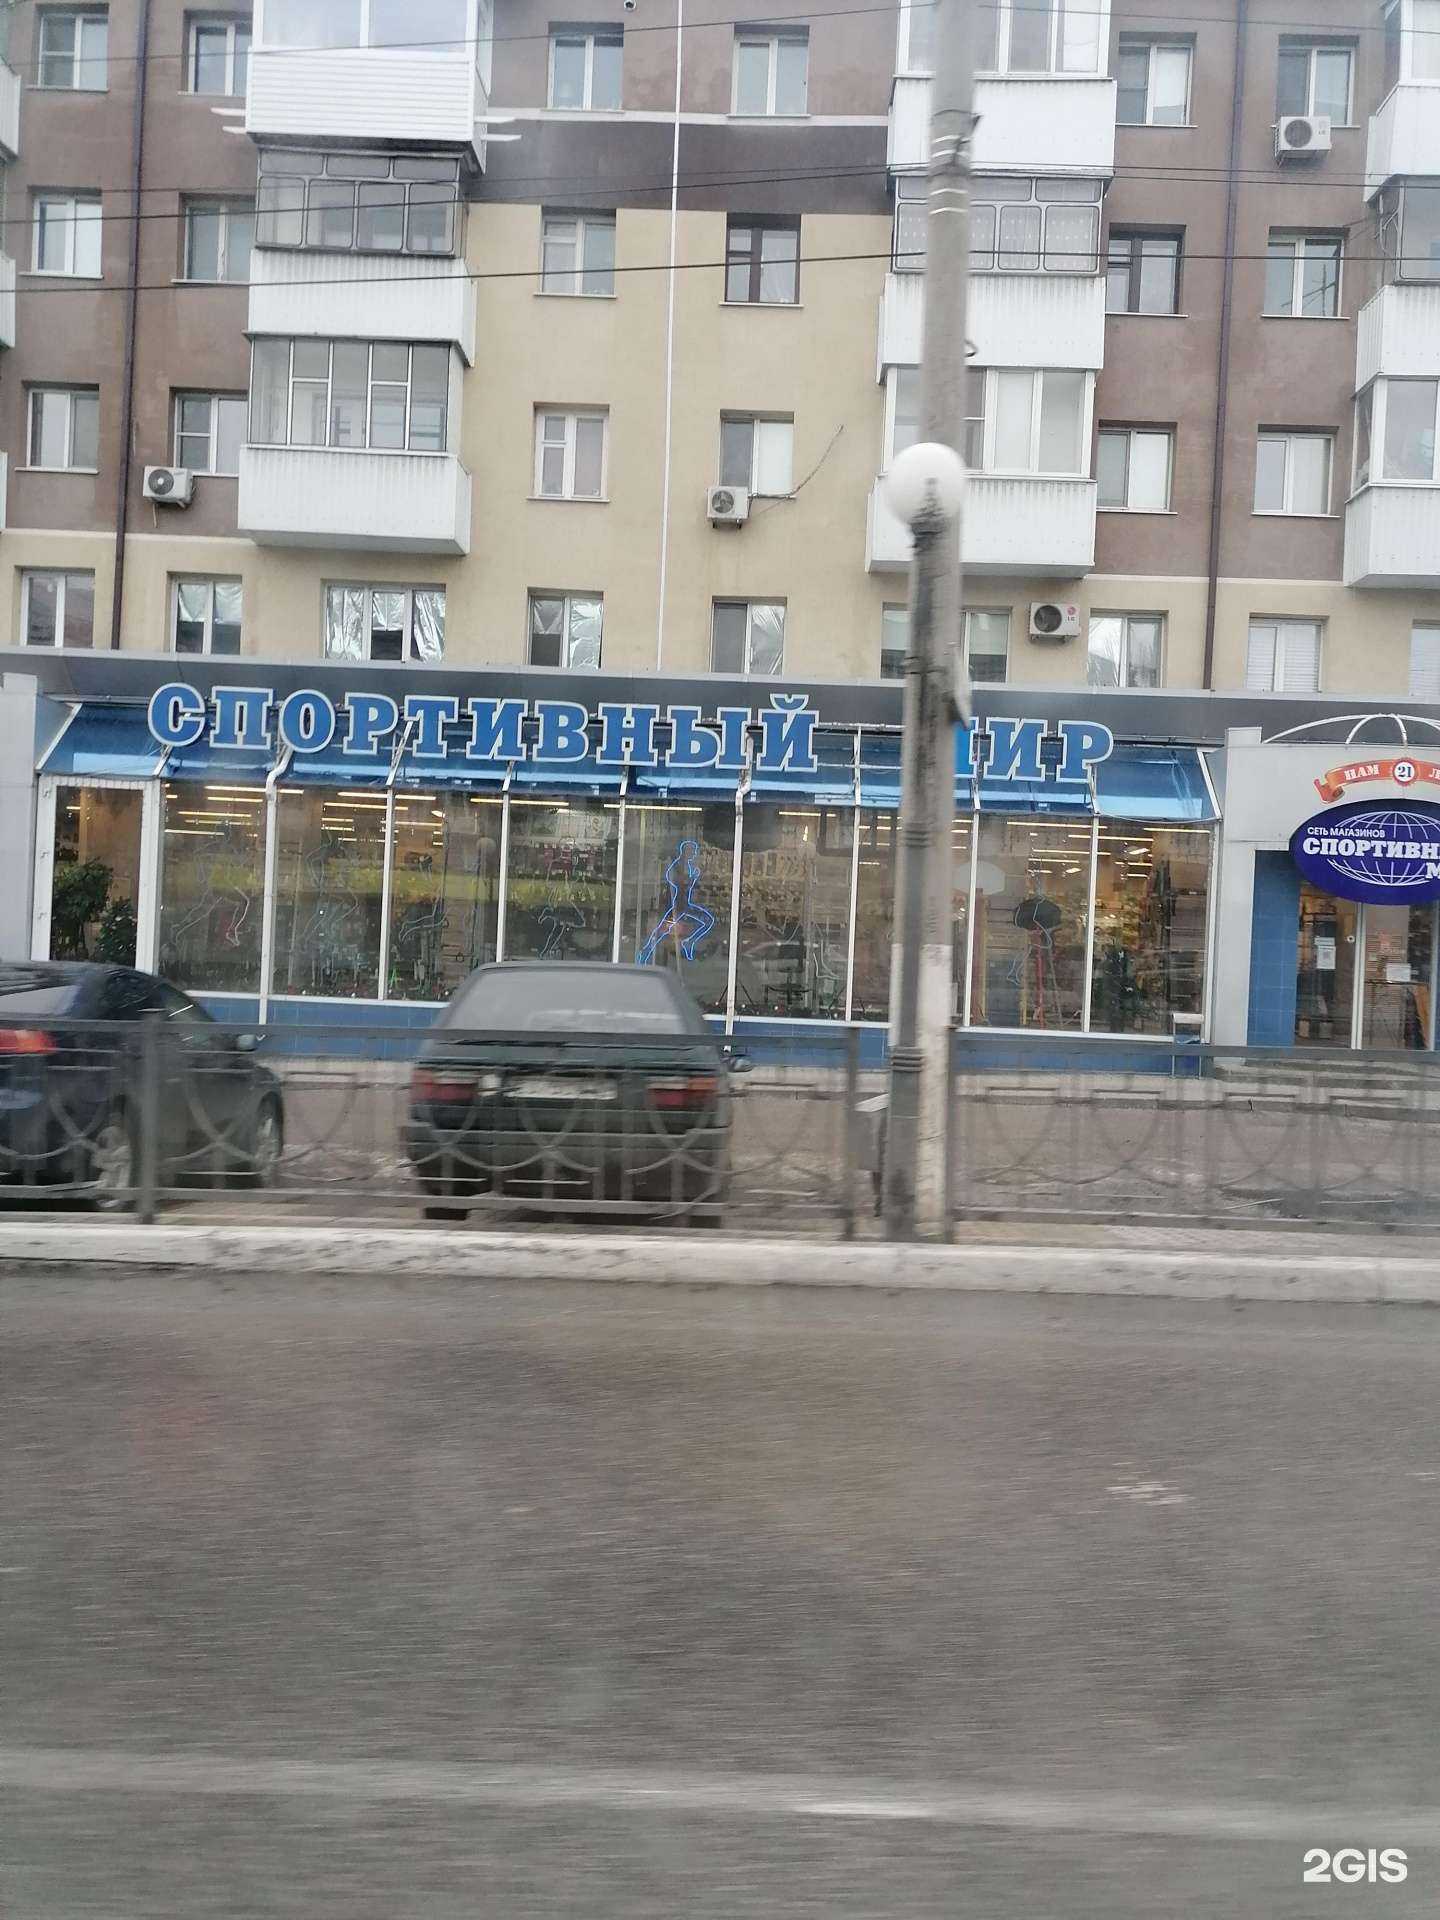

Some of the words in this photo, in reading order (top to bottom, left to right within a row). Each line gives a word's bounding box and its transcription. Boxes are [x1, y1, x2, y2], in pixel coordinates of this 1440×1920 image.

[148, 682, 820, 773] СПОРТИВНЫЙ
[1397, 765, 1412, 778] 21
[1307, 826, 1329, 836] СЕТЬ
[1329, 827, 1386, 838] МАГАЗИНОВ
